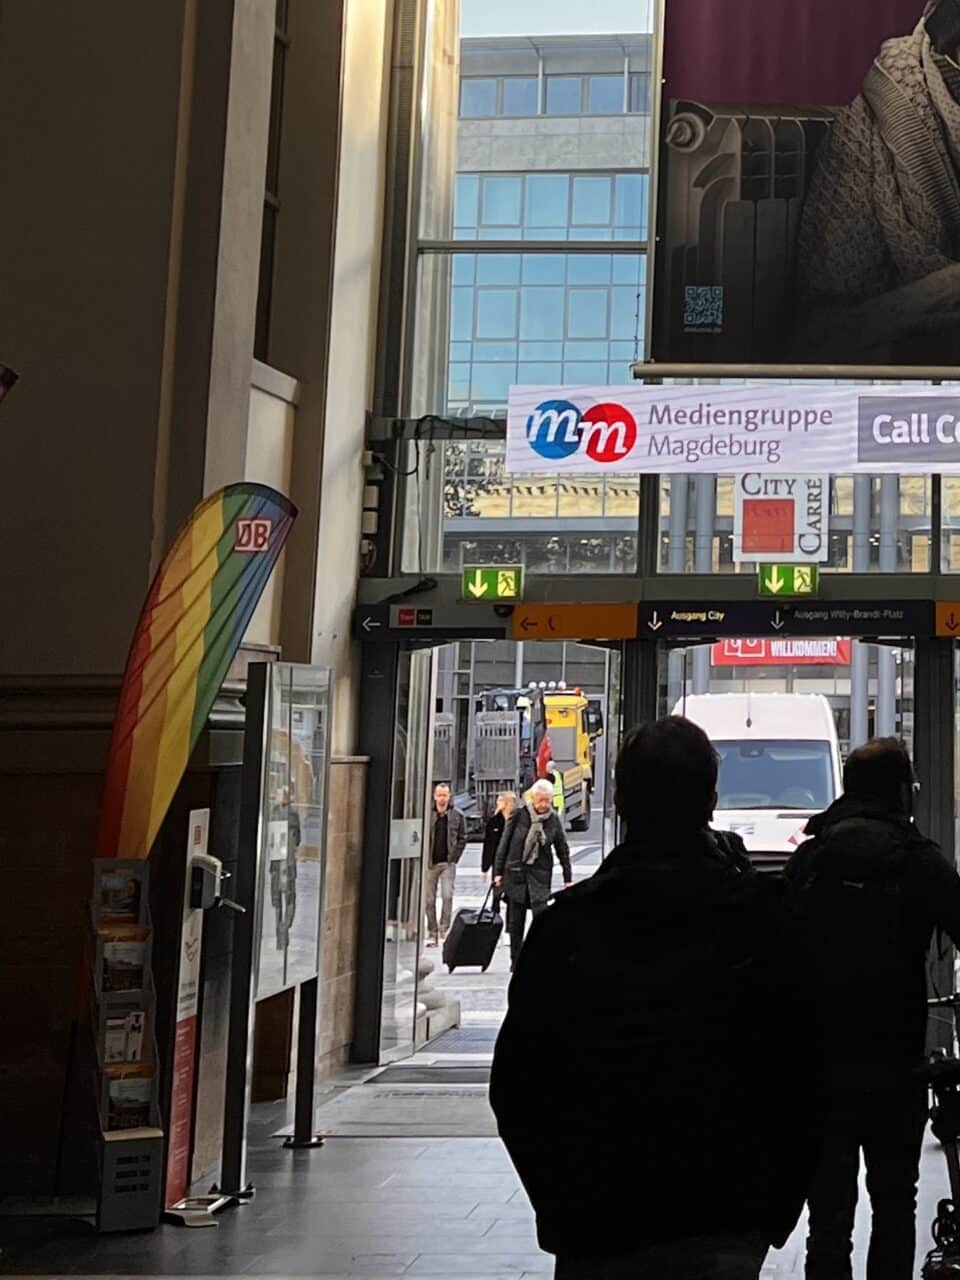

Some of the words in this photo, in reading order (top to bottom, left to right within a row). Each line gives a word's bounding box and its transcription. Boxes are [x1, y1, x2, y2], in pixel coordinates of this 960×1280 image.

[647, 404, 833, 434] Mediengruppe
[872, 413, 930, 446] Call
[647, 434, 781, 463] Magdeburg
[741, 473, 797, 495] CITY
[236, 521, 270, 550] DB
[670, 610, 706, 622] Ausgang
[708, 610, 725, 622] City
[793, 609, 829, 621] Ausgang
[771, 640, 838, 657] WILLKOMMEN!
